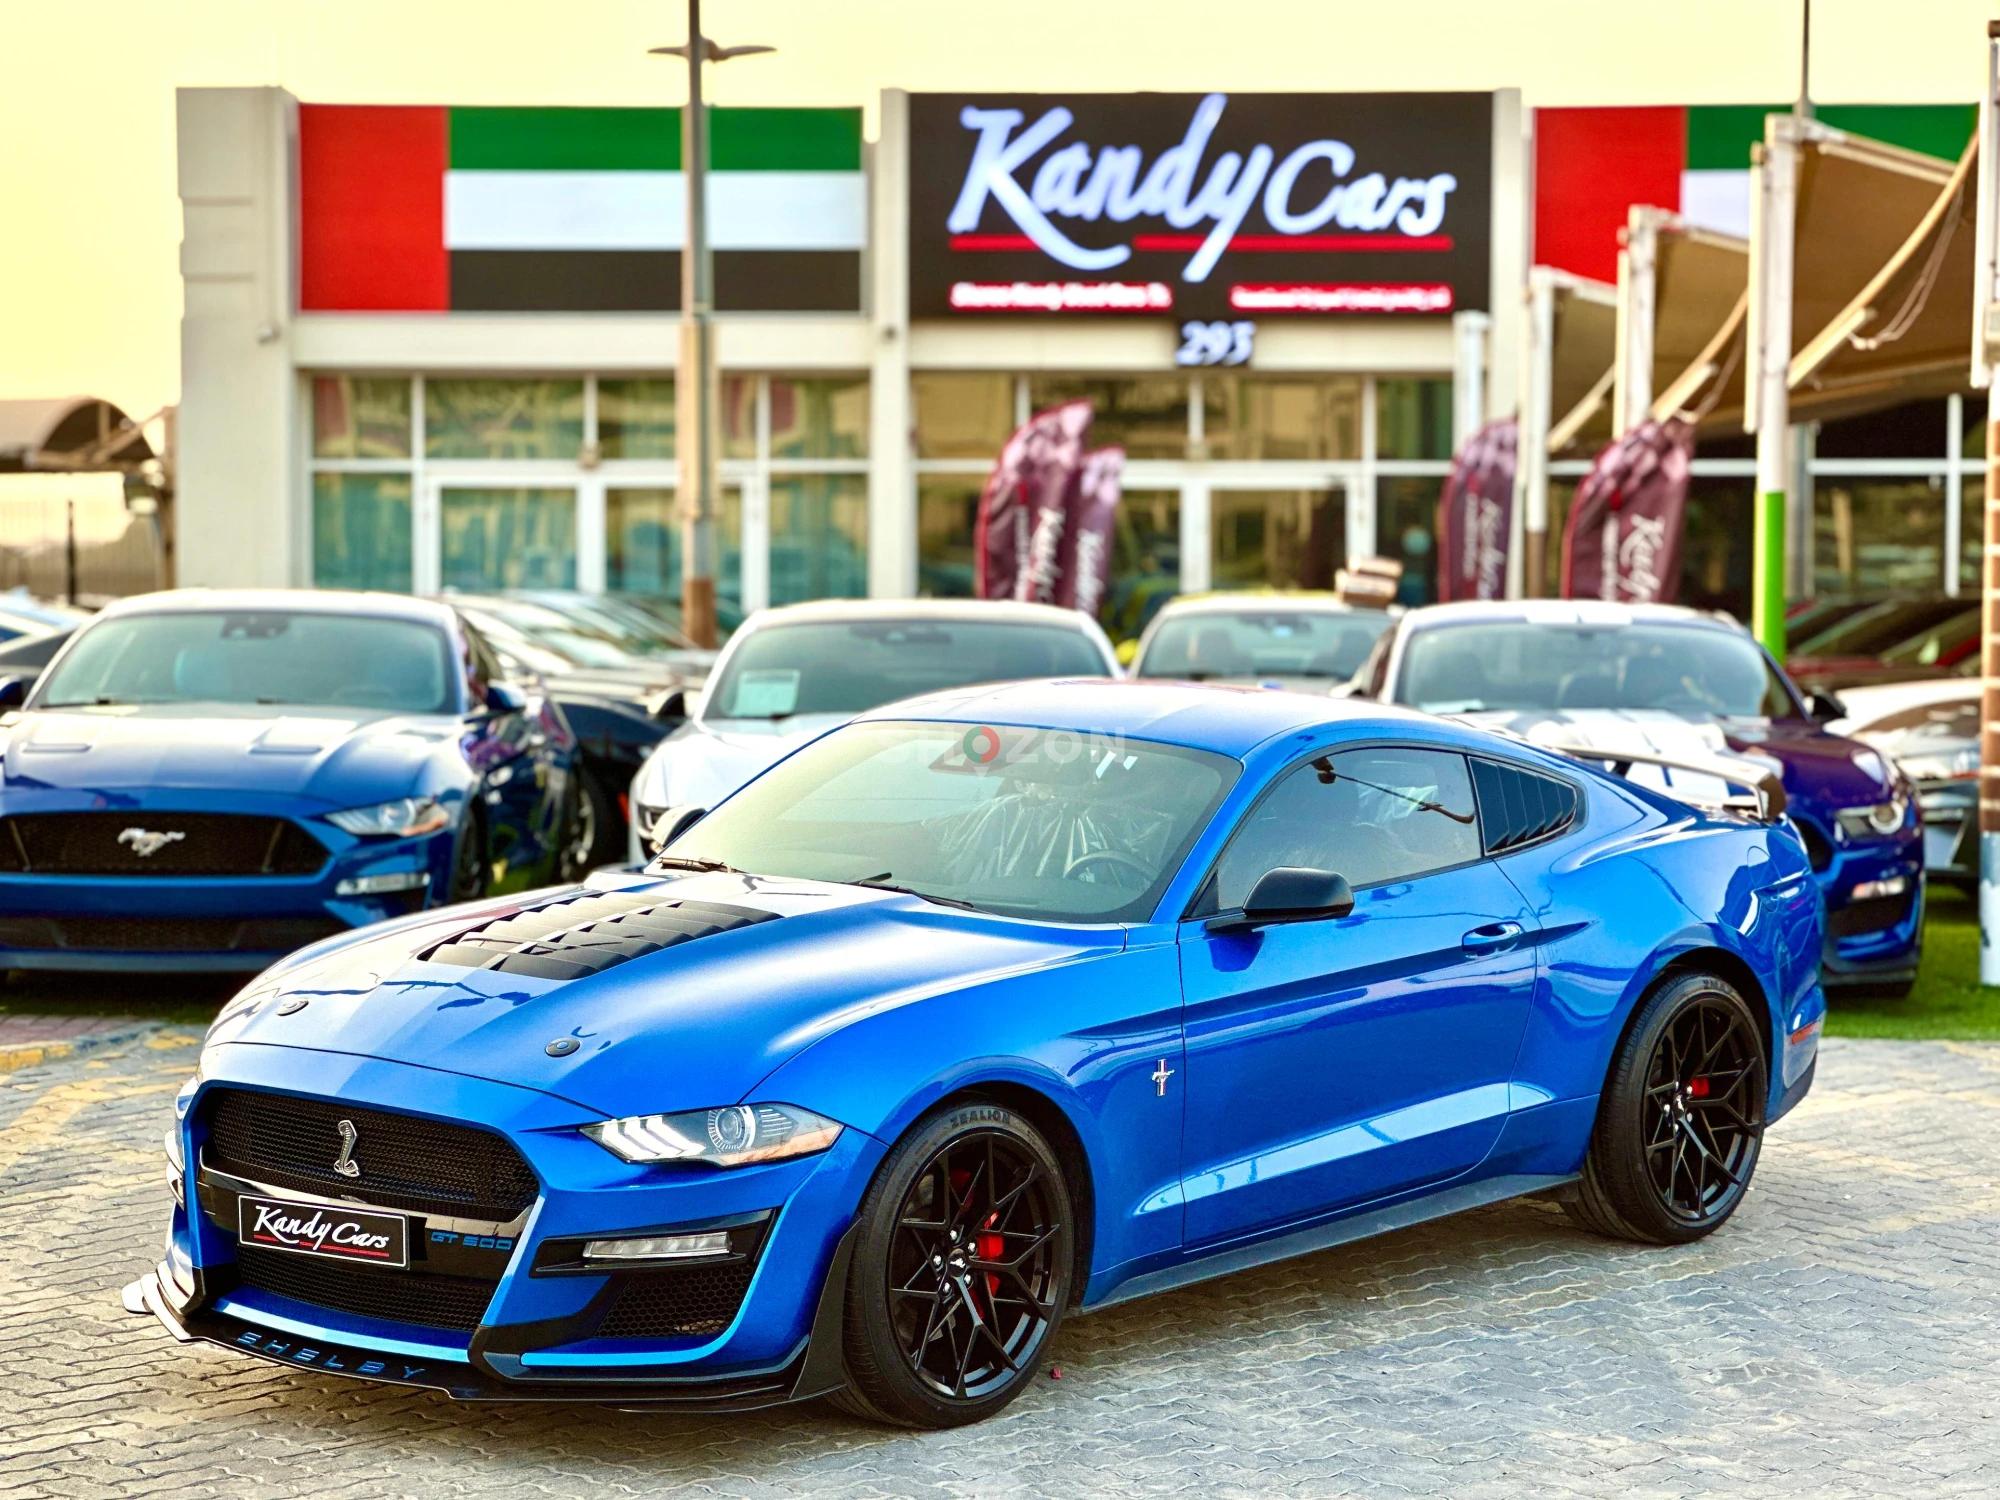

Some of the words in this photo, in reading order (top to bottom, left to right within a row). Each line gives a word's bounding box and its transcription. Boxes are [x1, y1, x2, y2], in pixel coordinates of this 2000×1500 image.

[947, 92, 1274, 283] Kandy
[1264, 138, 1458, 237] Cars
[950, 1110, 1011, 1128] ZEALION
[253, 1204, 333, 1251] Kandy
[331, 1222, 390, 1249] Cars
[430, 1231, 459, 1244] GT
[462, 1236, 513, 1250] 500
[236, 1331, 426, 1379] SHELBY
